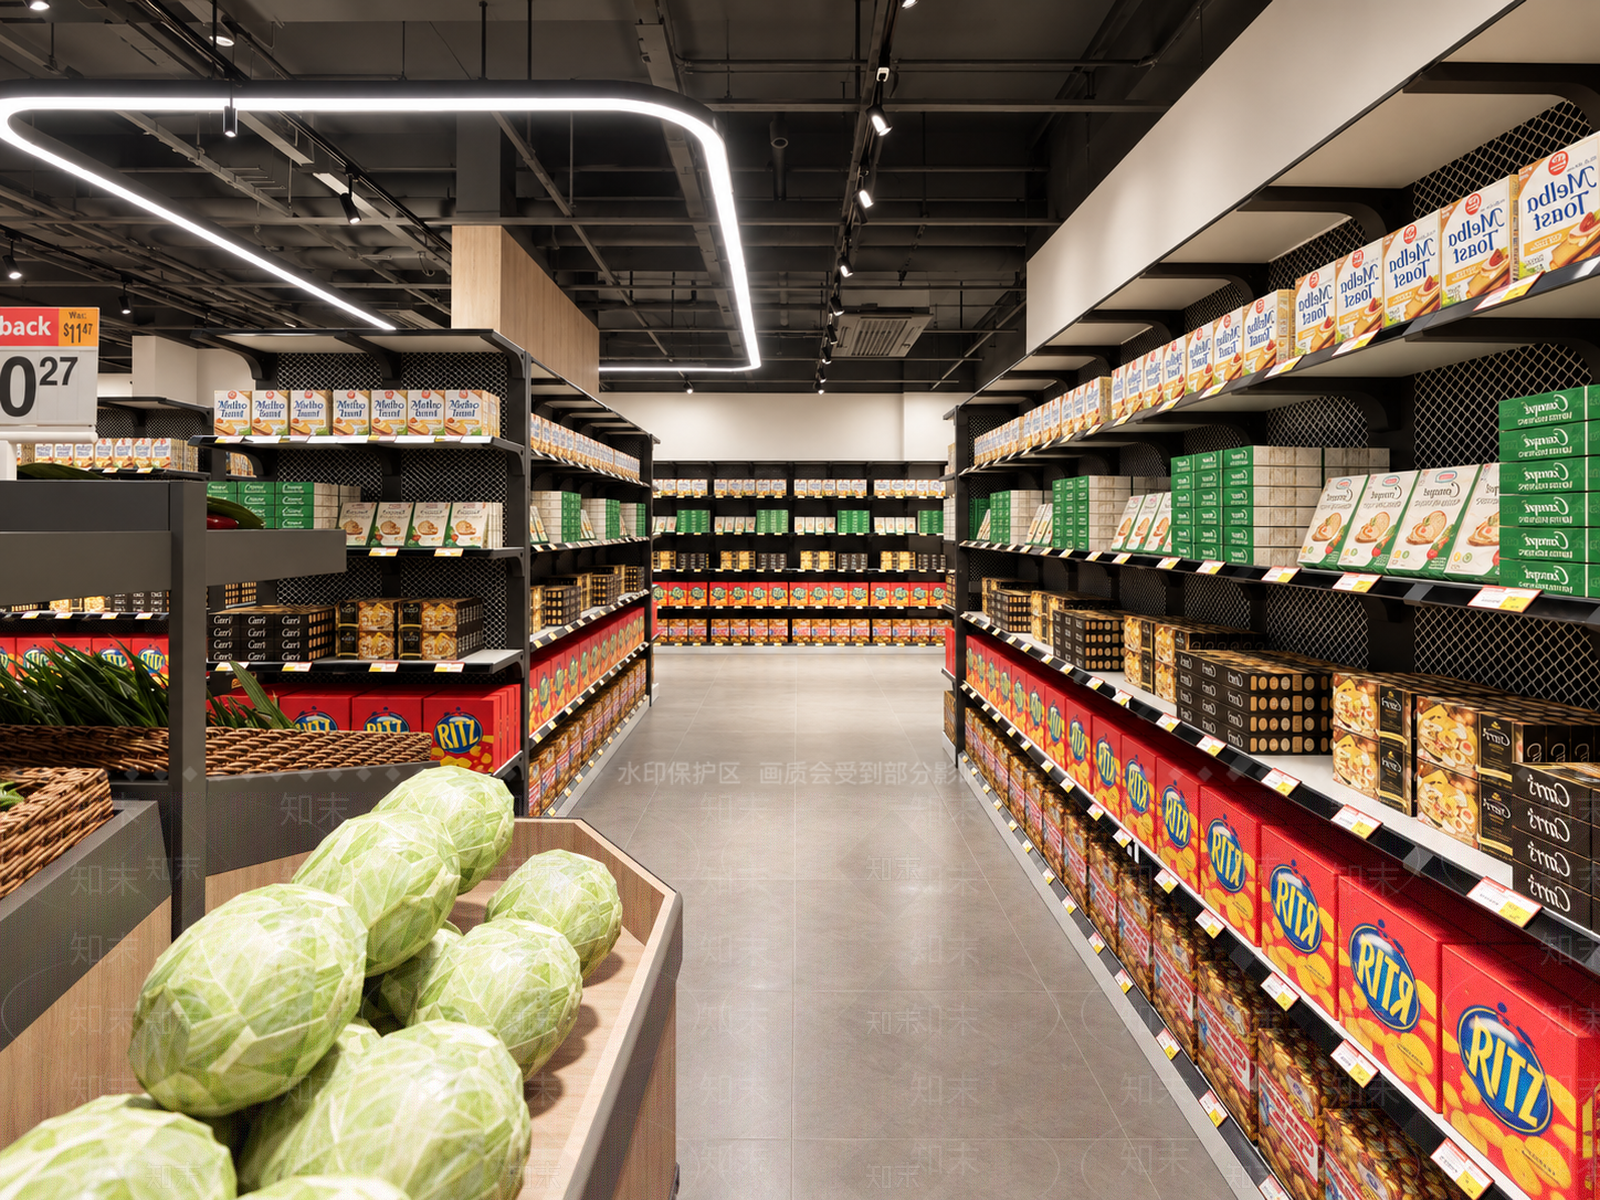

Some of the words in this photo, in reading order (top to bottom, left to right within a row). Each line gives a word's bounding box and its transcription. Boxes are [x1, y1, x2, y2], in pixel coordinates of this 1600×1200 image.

[0, 315, 51, 336] back
[437, 719, 479, 750] RITZ
[1465, 1014, 1547, 1128] RITZ
